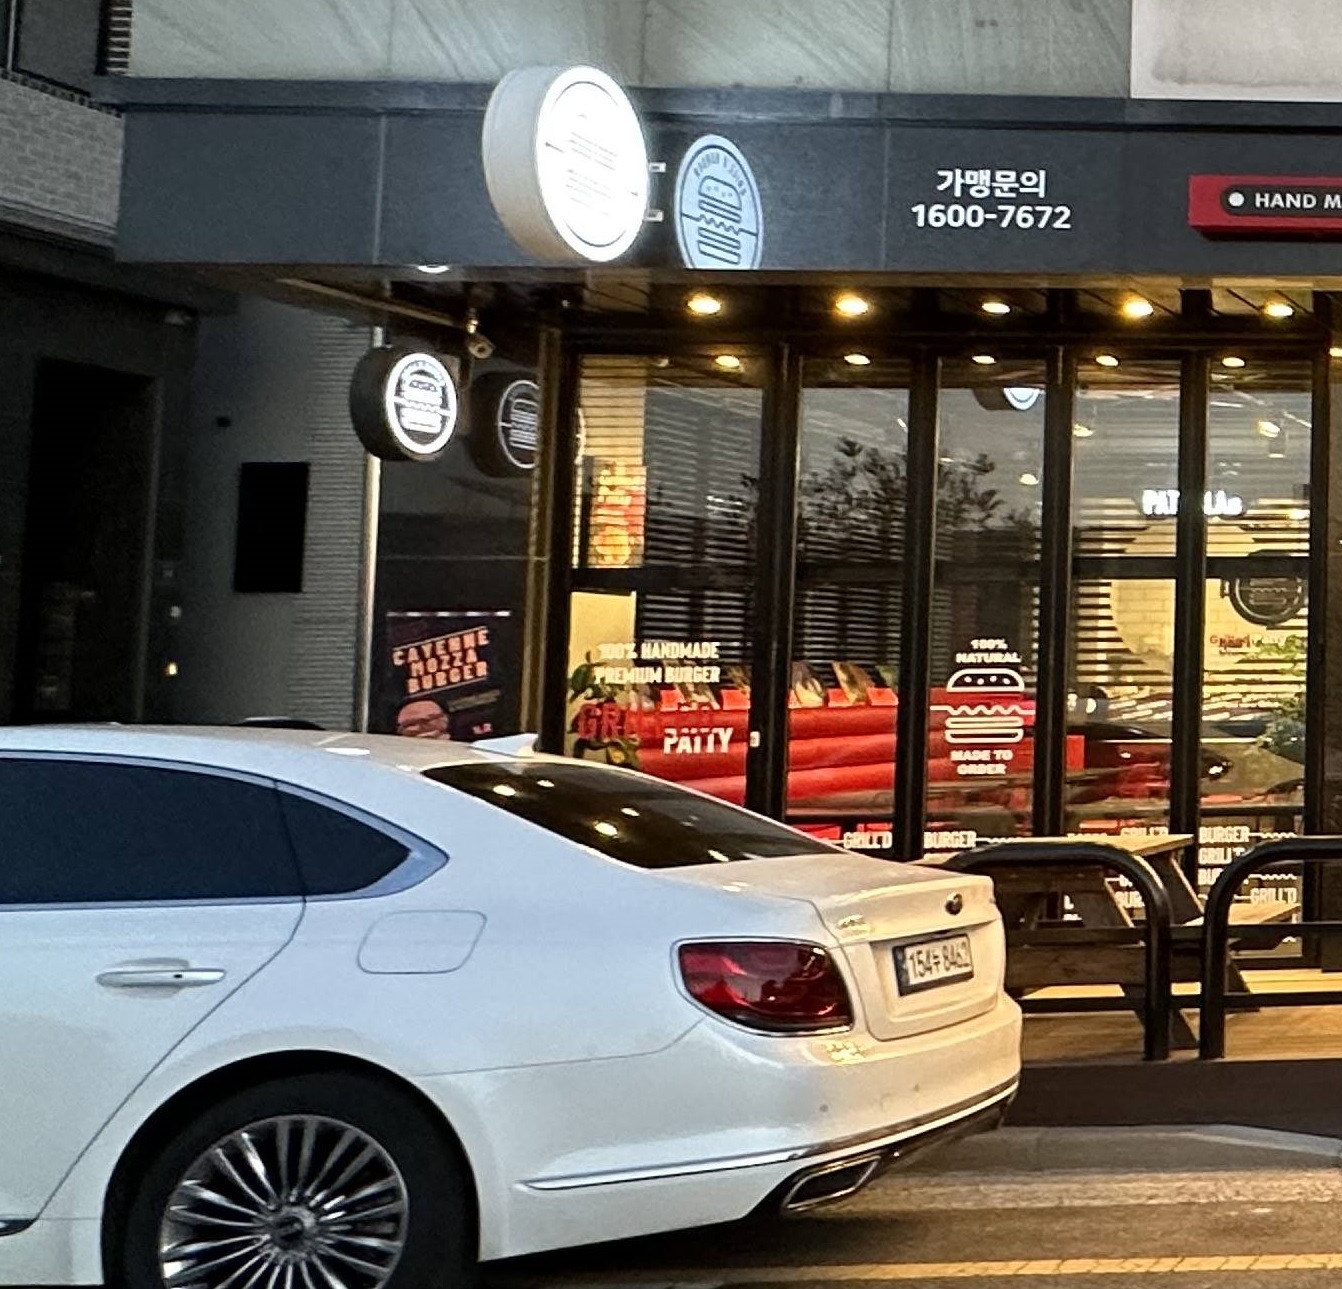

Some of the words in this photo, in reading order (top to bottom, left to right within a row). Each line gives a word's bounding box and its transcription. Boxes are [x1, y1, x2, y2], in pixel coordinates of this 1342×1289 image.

[936, 168, 1046, 198] 가맹문의
[1255, 192, 1317, 208] HAND
[911, 203, 1072, 229] 1600-7672
[641, 641, 721, 659] HANDMADE
[955, 652, 1022, 664] NATURAL
[664, 666, 721, 683] BURGER
[663, 727, 734, 755] PATTY
[1199, 826, 1250, 844] BURGER
